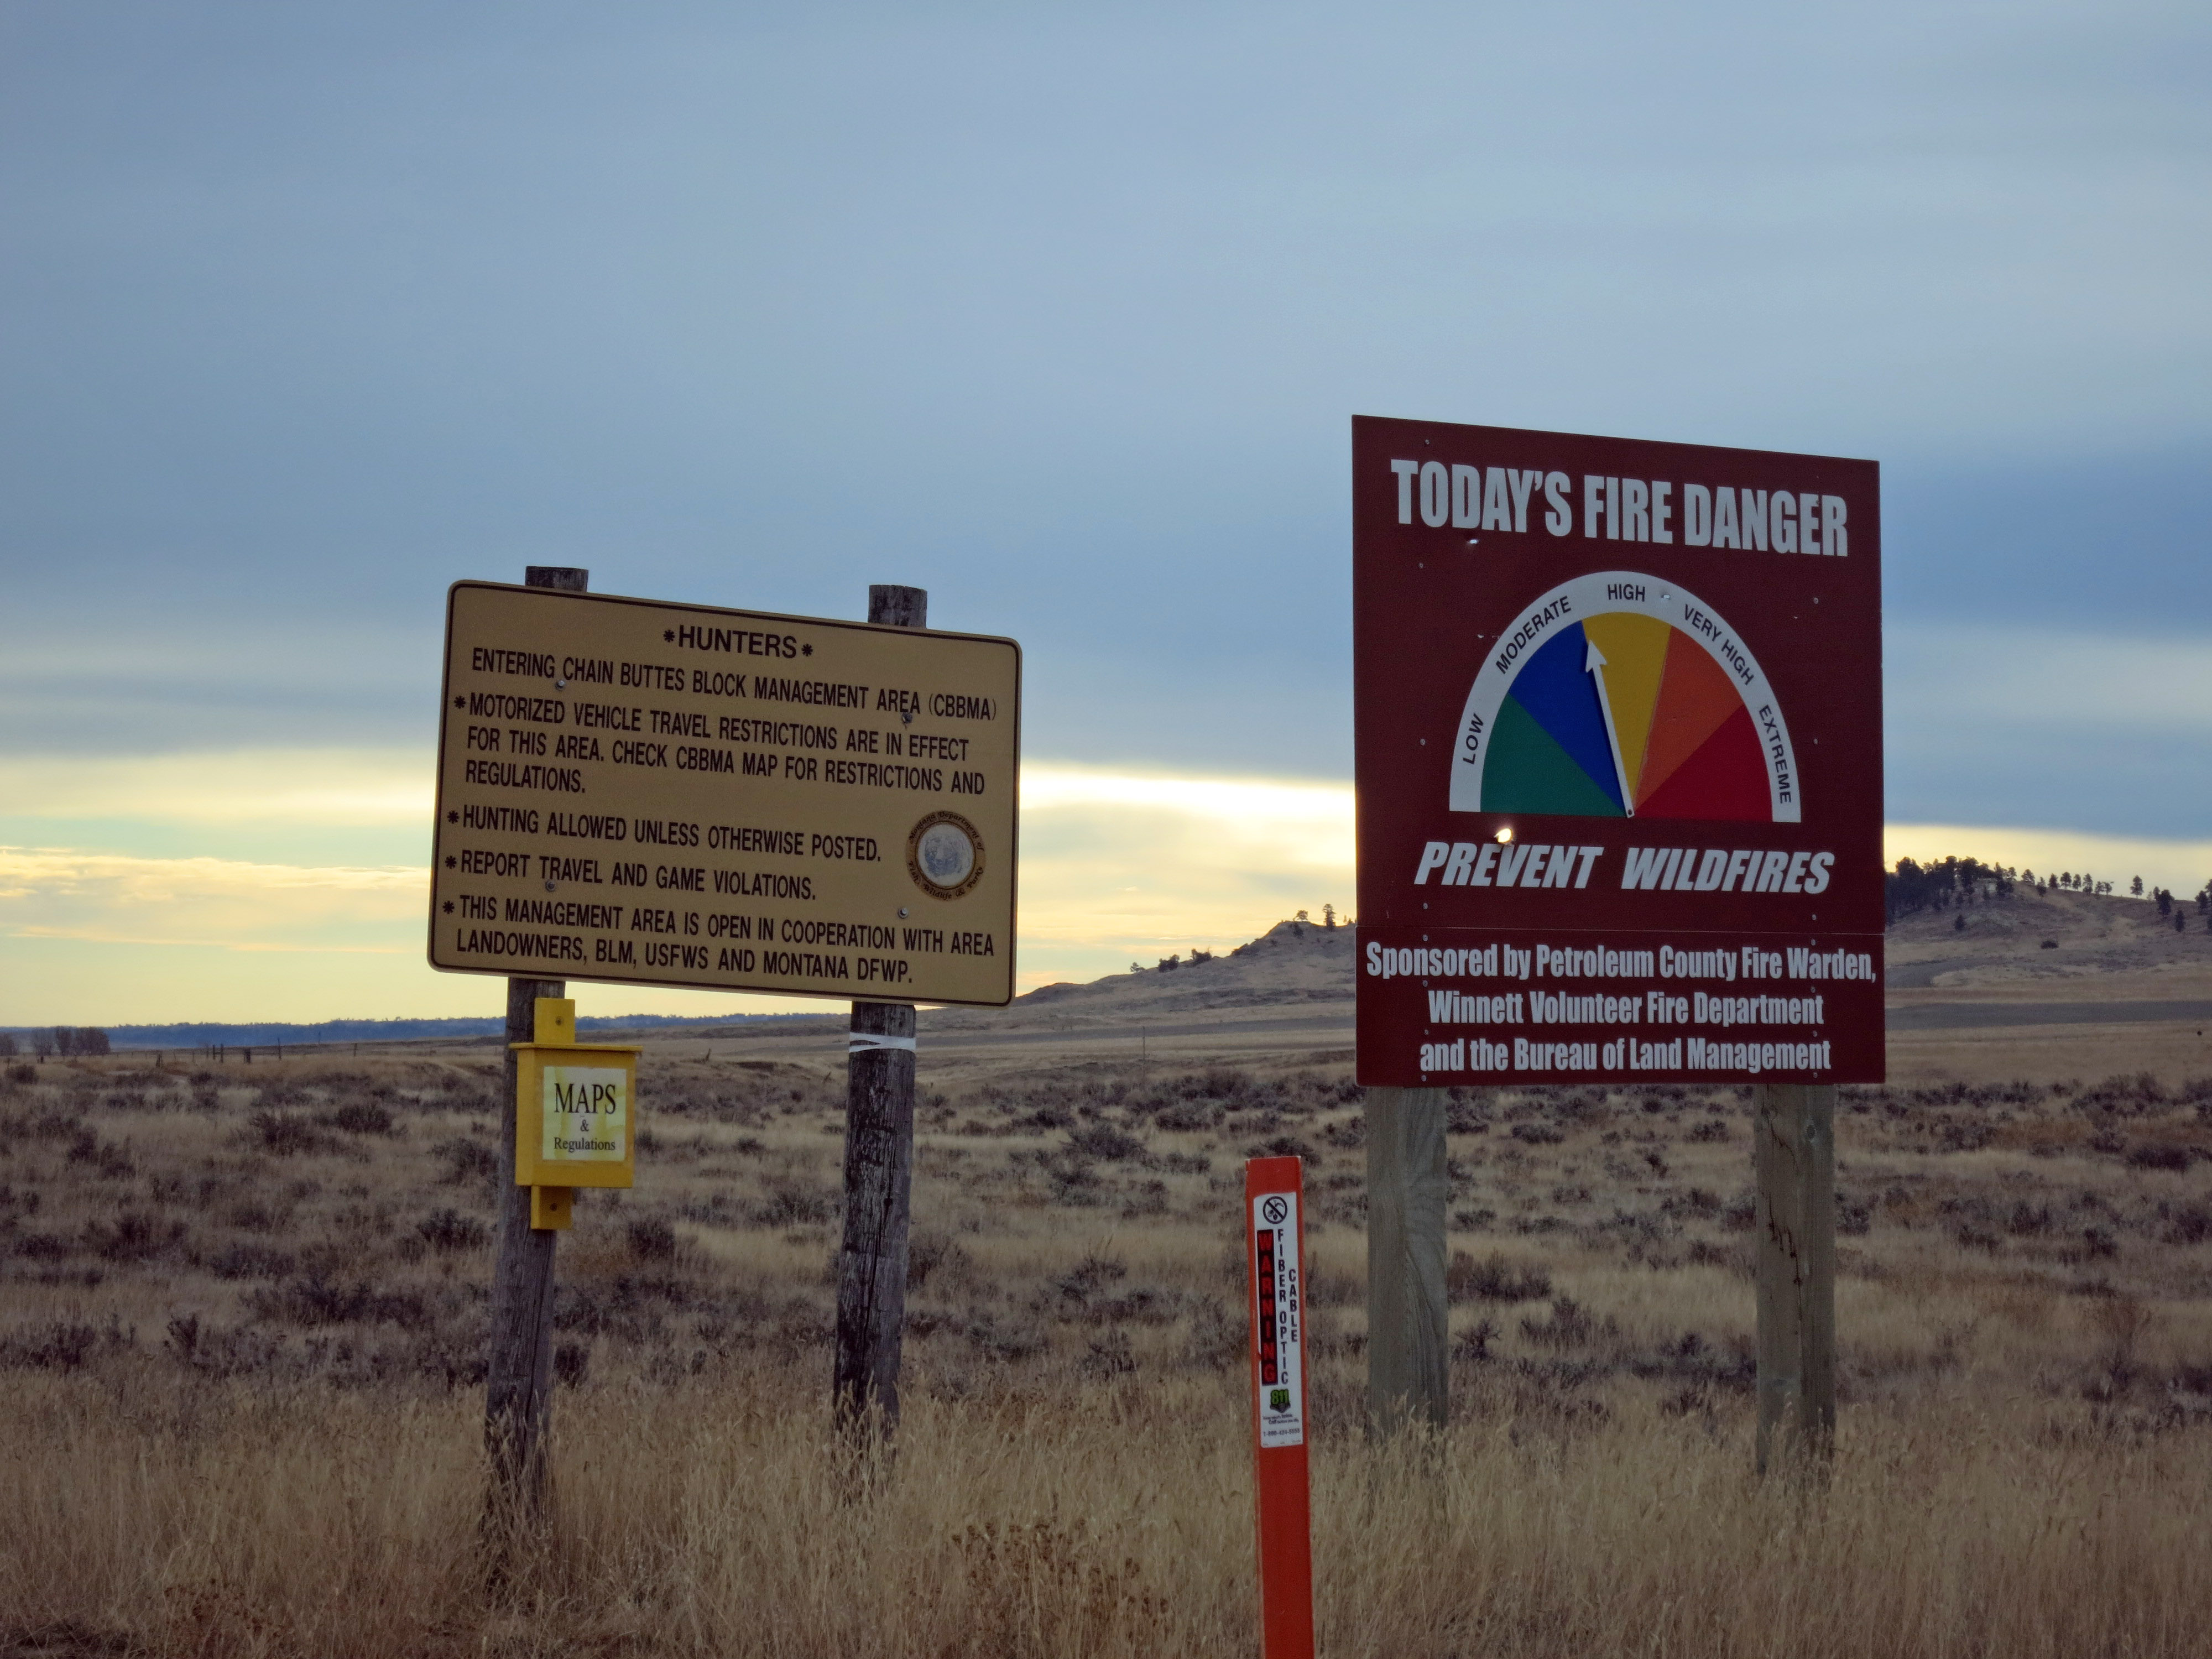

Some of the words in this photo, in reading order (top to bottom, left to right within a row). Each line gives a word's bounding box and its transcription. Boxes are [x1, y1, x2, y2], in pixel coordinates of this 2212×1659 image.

[1391, 459, 1572, 536] TODAY'S
[1584, 475, 1672, 544] FIRE
[1684, 483, 1848, 556] DANGER
[1608, 584, 1645, 602] HIGH
[1496, 596, 1571, 674] MODERATE
[1685, 604, 1722, 641] VERY
[1721, 639, 1754, 685] HIGH
[472, 648, 555, 678] ENTERING
[563, 657, 613, 684] CHAIN
[620, 662, 685, 691] BUTTES
[693, 670, 746, 697] BLOCK
[754, 676, 869, 708] MANAGEMENT
[877, 688, 920, 714] AREA
[929, 694, 996, 720] (CBBMA)
[469, 692, 565, 723] MOTORIZED
[574, 703, 641, 731] VEHICLE
[650, 710, 711, 738] TRAVEL
[719, 717, 837, 749] RESTRICTIONS
[846, 729, 878, 753] ARE
[886, 733, 901, 755] IN
[910, 734, 969, 761] EFFECT
[1463, 713, 1483, 764] LOW
[466, 760, 585, 793] REGULATIONS.
[467, 726, 500, 751] FOR
[509, 730, 546, 755] THIS
[555, 735, 603, 761] AREA.
[613, 740, 667, 767] CHECK
[676, 746, 734, 773] CBBMA
[743, 752, 778, 776] MAP
[785, 756, 817, 780] FOR
[826, 760, 942, 791] RESTRICTIONS
[951, 771, 984, 795] AND
[1759, 705, 1791, 804] EXTREME
[463, 805, 539, 833] HUNTING
[547, 812, 626, 841] ALLOWED
[635, 819, 698, 847] UNLESS
[708, 826, 804, 855] OTHERWISE
[812, 834, 880, 861] POSTED.
[909, 815, 935, 844] Montana
[937, 811, 979, 839] Department
[976, 842, 984, 851] of
[461, 850, 530, 877] REPORT
[539, 856, 602, 883] TRAVEL
[612, 862, 647, 886] AND
[656, 865, 705, 891] GAME
[714, 870, 815, 900] VIOLATIONS.
[956, 888, 966, 897] &
[1414, 842, 1604, 888] PREVENT
[1621, 848, 1834, 894] WILDFIRES
[460, 895, 497, 920] THIS
[505, 898, 623, 929] MANAGEMENT
[631, 909, 676, 933] AREA
[685, 912, 699, 935] IS
[708, 914, 750, 939] OPEN
[758, 917, 774, 941] IN
[782, 919, 894, 949] COOPERATION
[903, 928, 942, 952] WITH
[951, 932, 994, 956] AREA
[457, 928, 587, 964] LANDOWNERS,
[596, 939, 636, 969] BLM,
[645, 943, 708, 969] USFWS
[718, 948, 755, 972] AND
[764, 951, 848, 979] MONTANA
[858, 958, 911, 983] DFWP.
[1367, 942, 1498, 979] Sponsored
[1504, 944, 1531, 980] by
[1537, 945, 1653, 977] Petroleum
[1660, 945, 1736, 981] County
[1743, 947, 1782, 978] Fire
[1787, 948, 1876, 983] Warden,
[1428, 990, 1524, 1023] Winnett
[1530, 992, 1642, 1023] Volunteer
[1647, 992, 1688, 1024] Fire
[1694, 992, 1824, 1027] Department
[1421, 1039, 1464, 1071] and
[1470, 1039, 1508, 1071] the
[1515, 1038, 1597, 1070] Bureau
[1603, 1038, 1625, 1070] of
[1630, 1038, 1681, 1070] Land
[1688, 1038, 1831, 1073] Management
[555, 1083, 615, 1114] MAPS
[580, 1119, 589, 1131] &
[554, 1138, 615, 1153] Regulations
[1277, 1228, 1287, 1302] FIBER
[1258, 1233, 1275, 1383] WARNING
[1288, 1269, 1297, 1342] CABLE
[1279, 1311, 1289, 1385] OPTIC
[1270, 1389, 1289, 1405] 811
